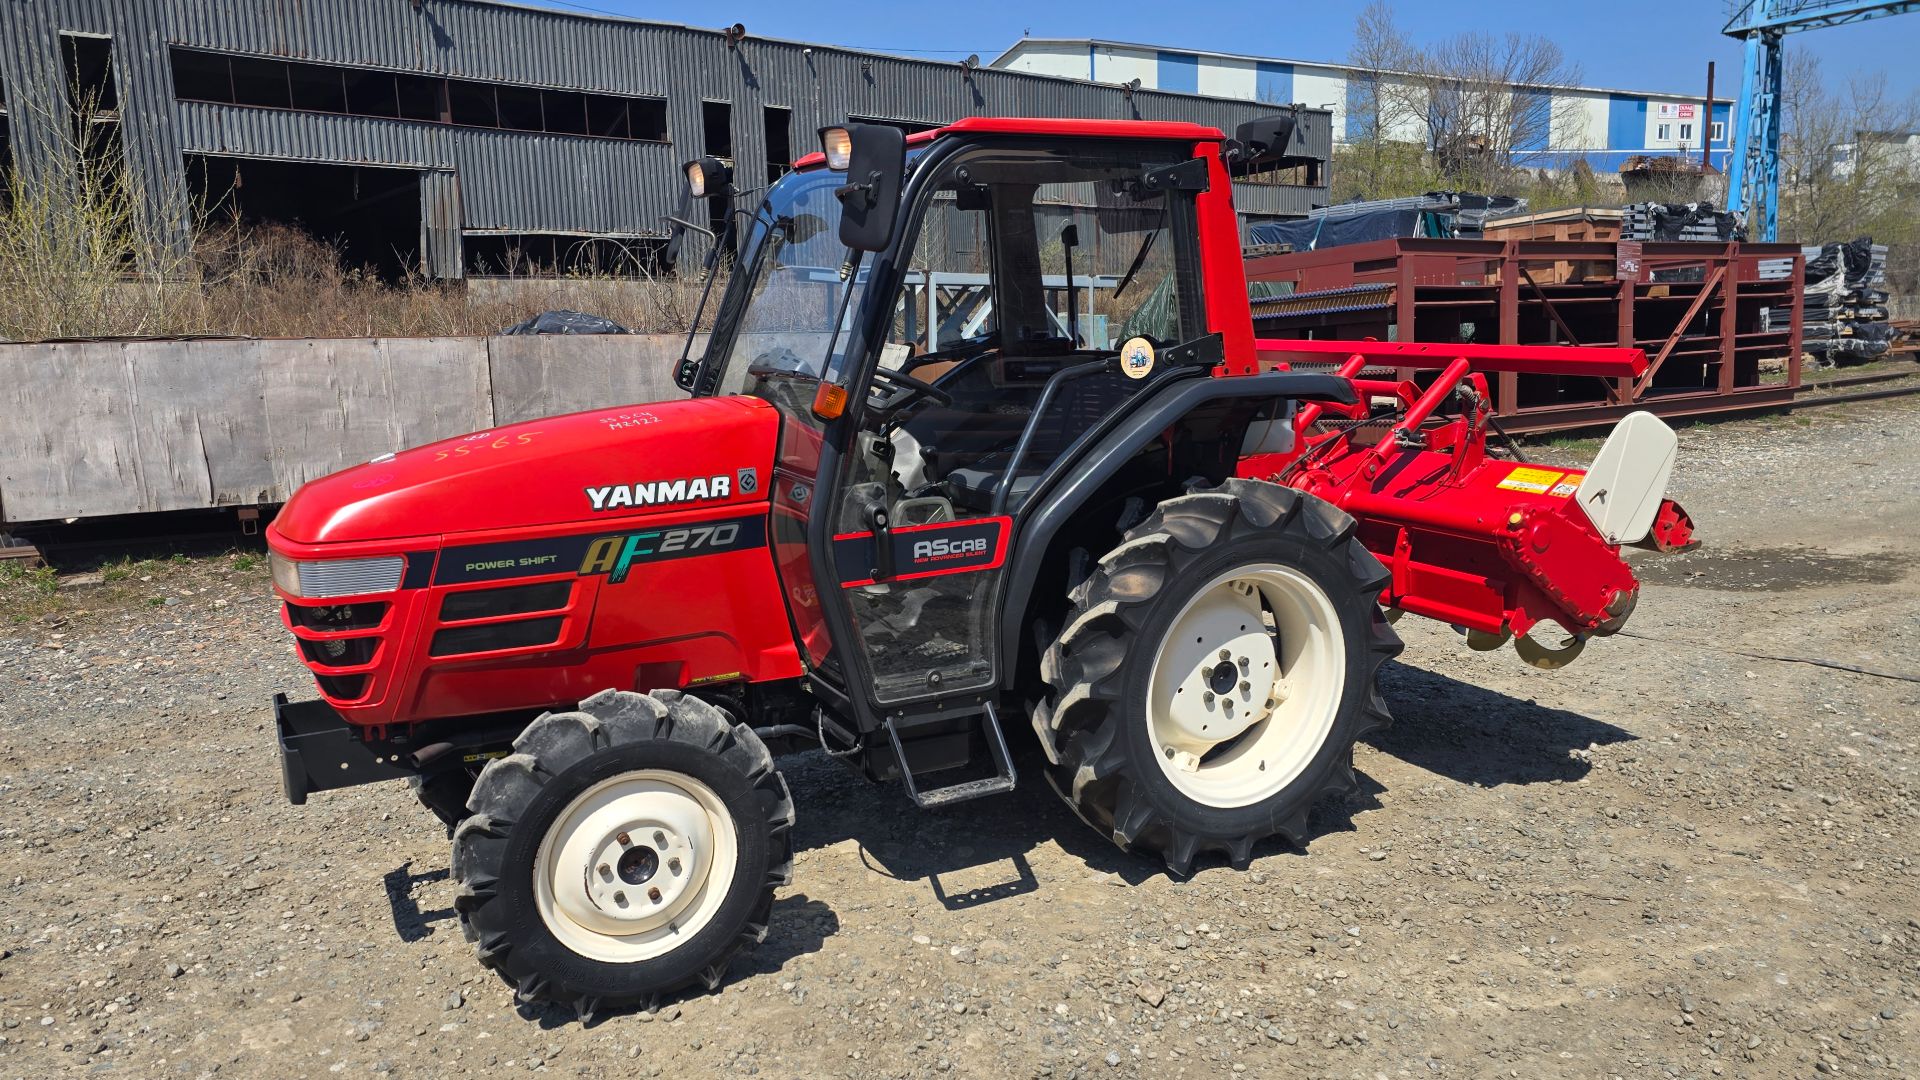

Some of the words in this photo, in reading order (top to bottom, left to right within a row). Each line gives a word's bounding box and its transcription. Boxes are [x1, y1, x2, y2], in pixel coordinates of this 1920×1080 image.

[586, 476, 730, 509] YANMAR
[465, 559, 515, 572] POWER
[519, 555, 557, 566] SHIFT
[930, 552, 965, 561] ADVANCED
